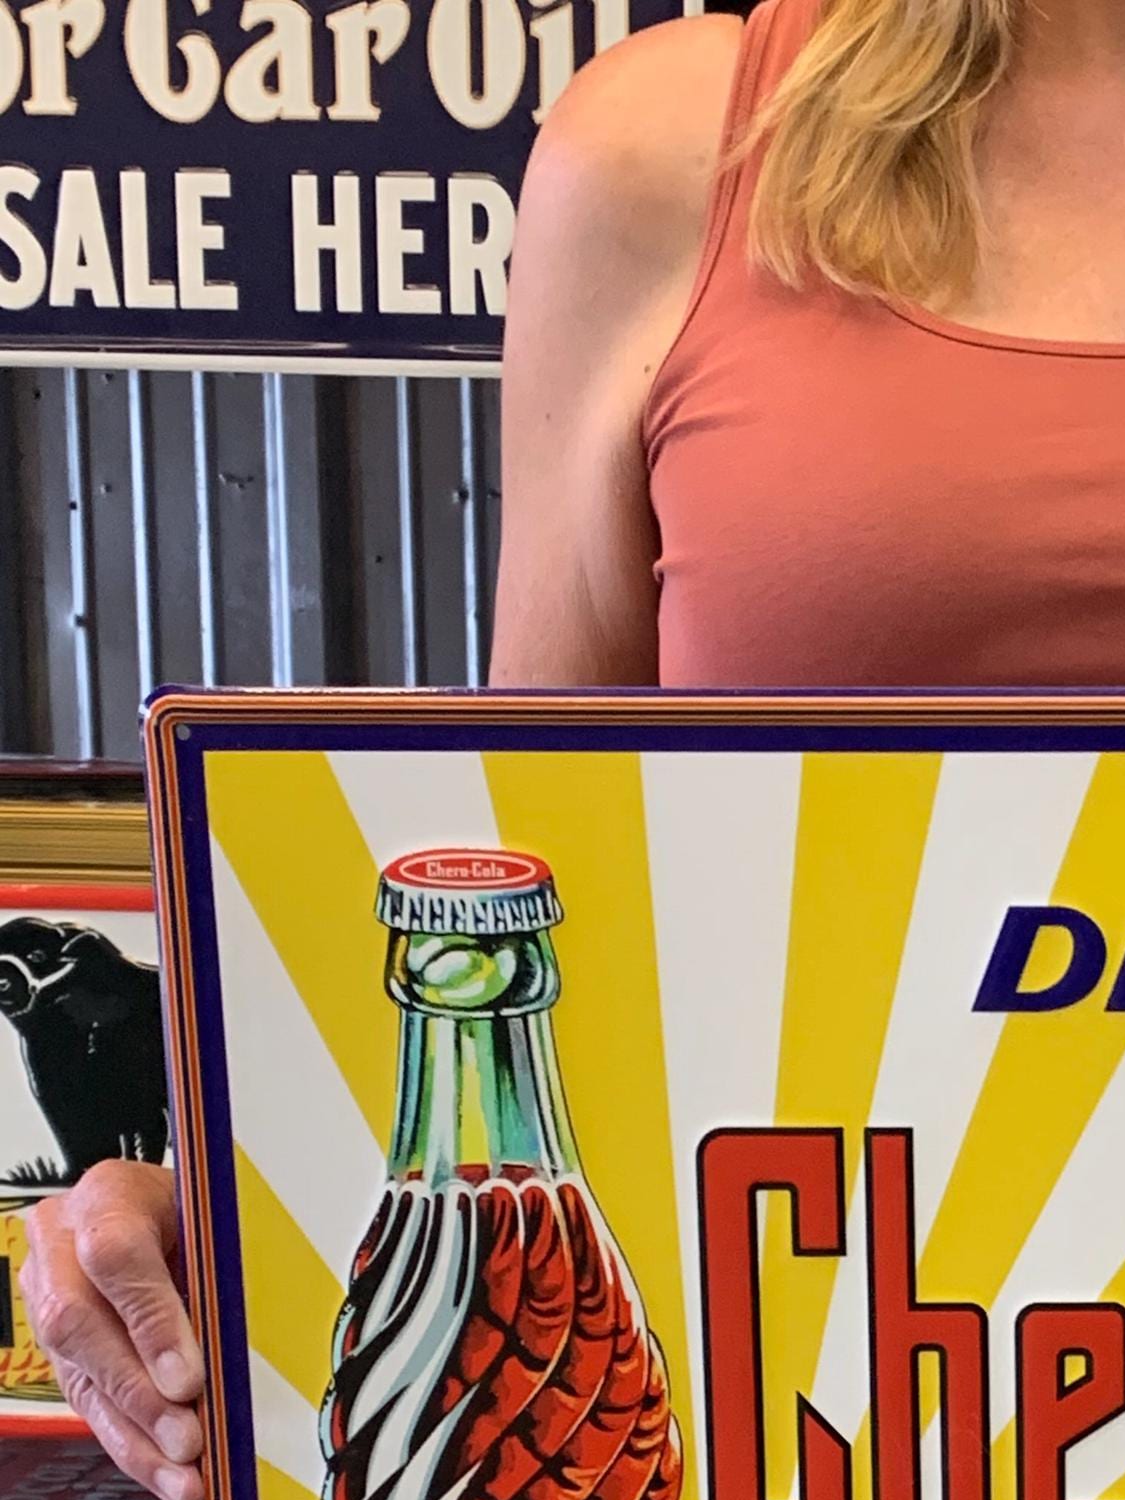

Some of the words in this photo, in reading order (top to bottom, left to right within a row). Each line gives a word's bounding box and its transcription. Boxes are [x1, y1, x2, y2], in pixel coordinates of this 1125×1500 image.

[124, 0, 412, 123] Car
[0, 165, 239, 311] SALE
[425, 861, 506, 880] Chero-Cola
